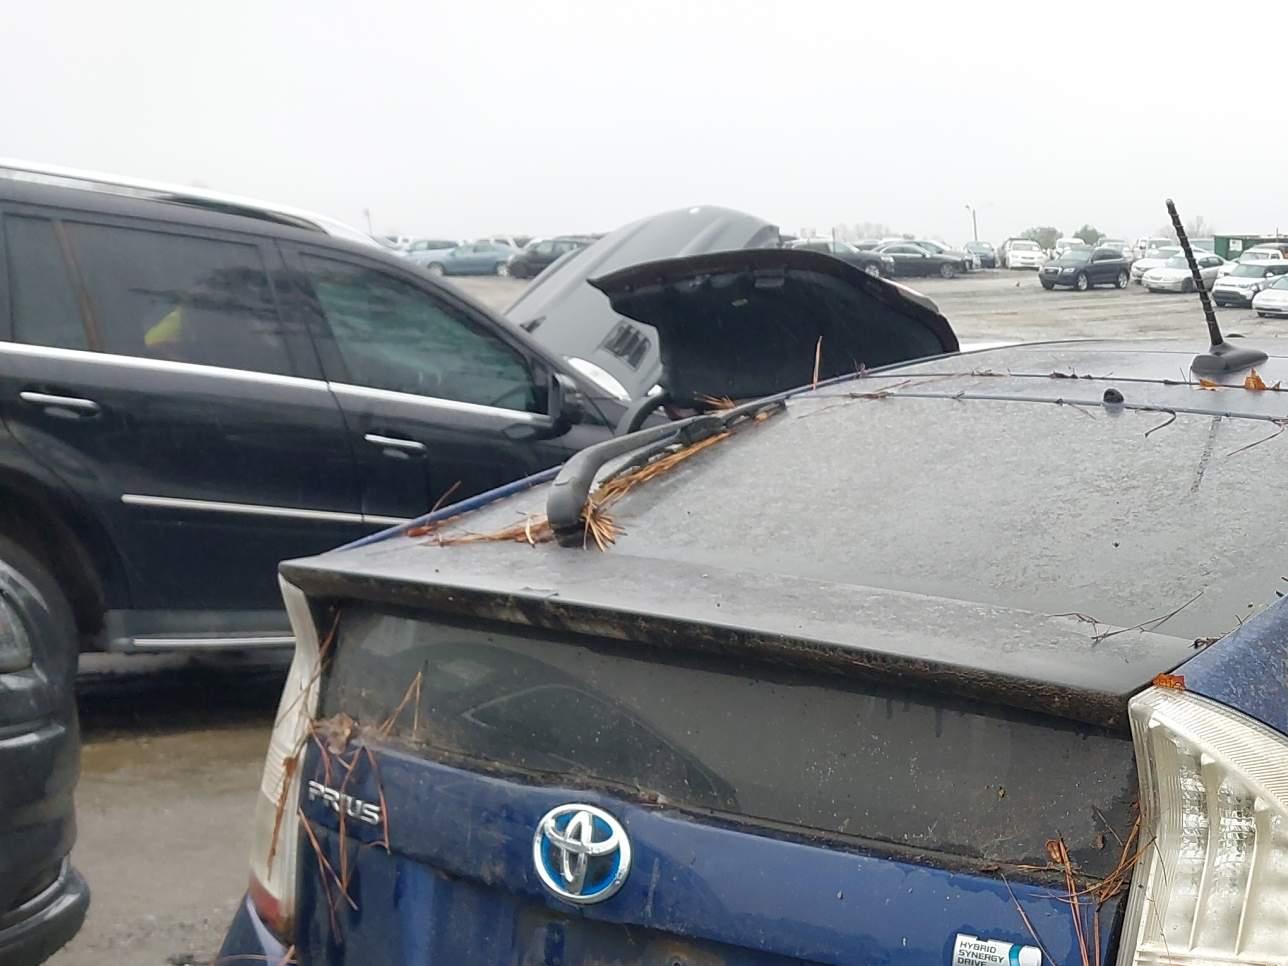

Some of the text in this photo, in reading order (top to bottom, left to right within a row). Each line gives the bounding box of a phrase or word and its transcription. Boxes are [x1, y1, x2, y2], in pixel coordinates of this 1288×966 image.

[308, 780, 380, 825] PRUS
[960, 941, 997, 953] HYBRID
[958, 949, 1005, 963] SYNERGY
